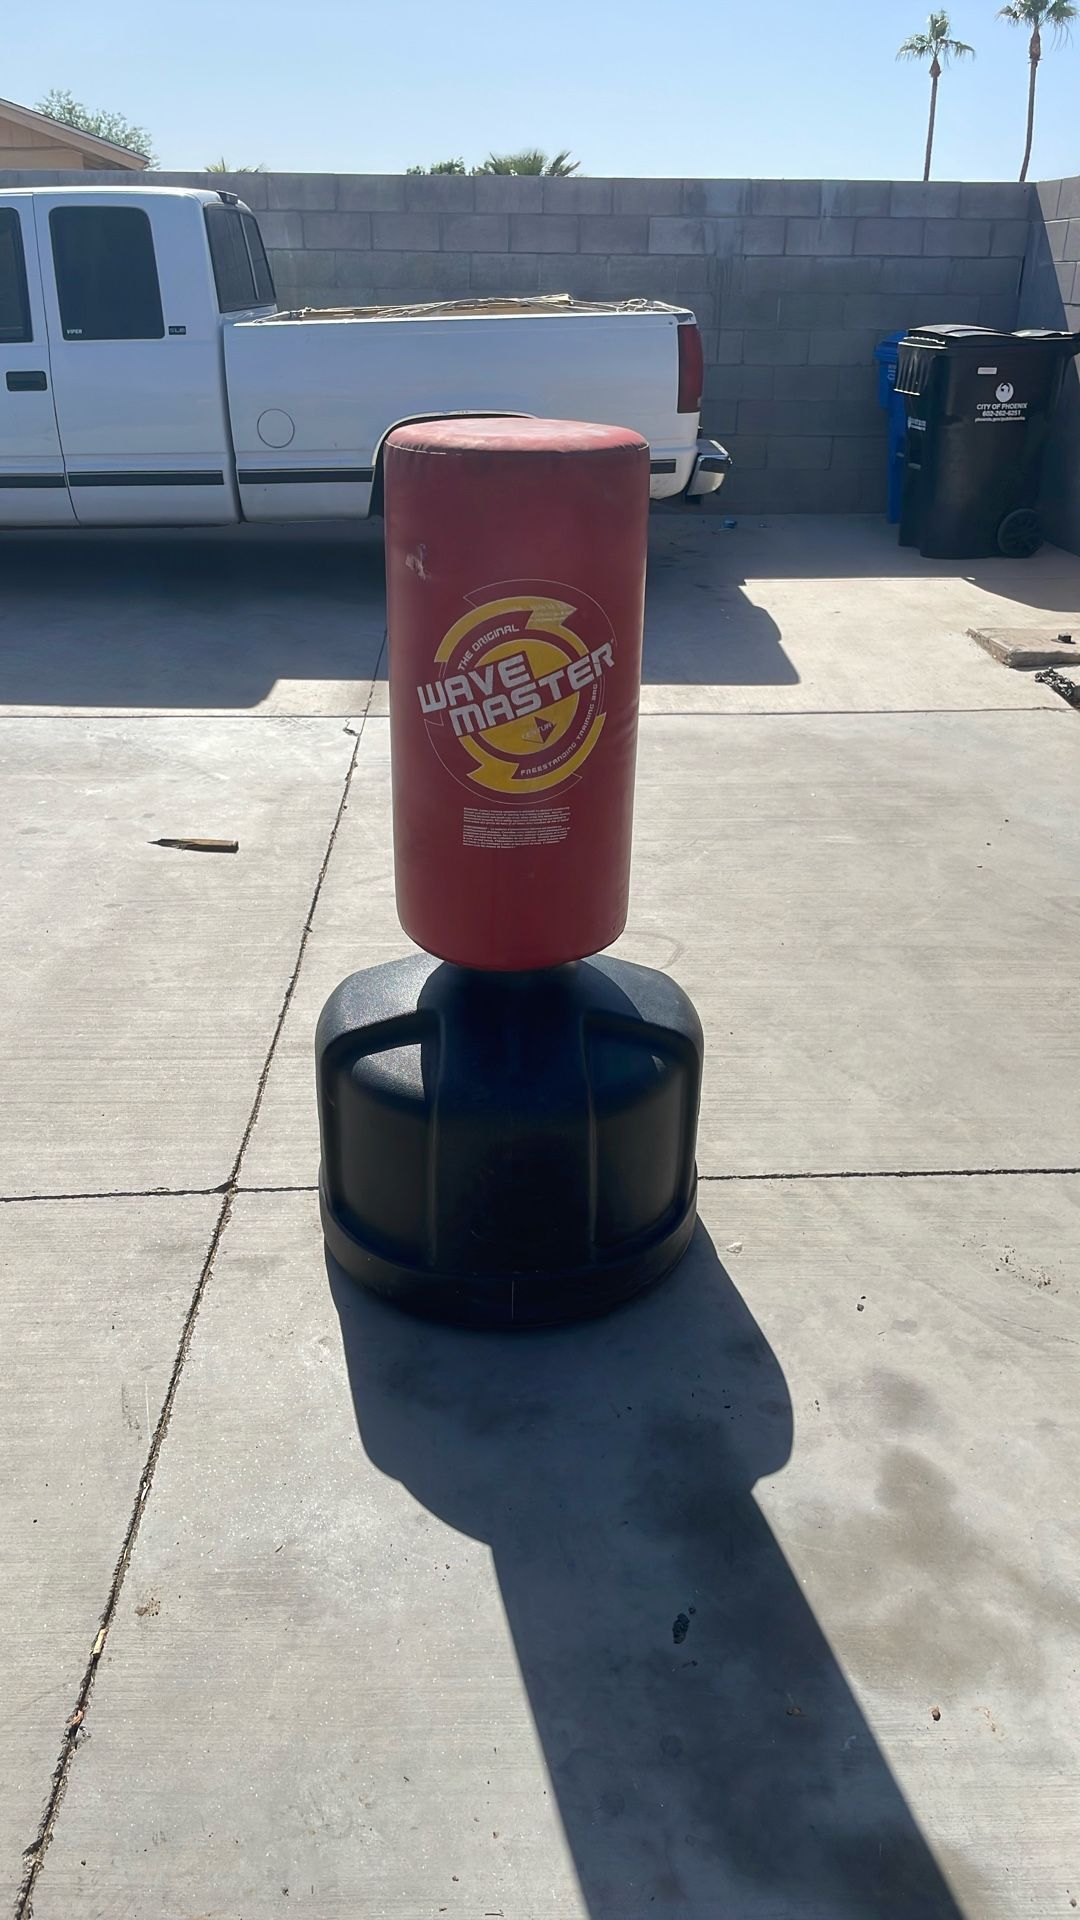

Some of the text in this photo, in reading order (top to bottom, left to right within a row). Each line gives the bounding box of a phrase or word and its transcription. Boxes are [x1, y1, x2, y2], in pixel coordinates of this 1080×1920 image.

[457, 624, 520, 671] THE ORIGINAL
[417, 653, 531, 714] WAVE
[448, 641, 615, 737] MASTER
[520, 742, 577, 776] FREESTANDING
[576, 703, 595, 740] TRAINING
